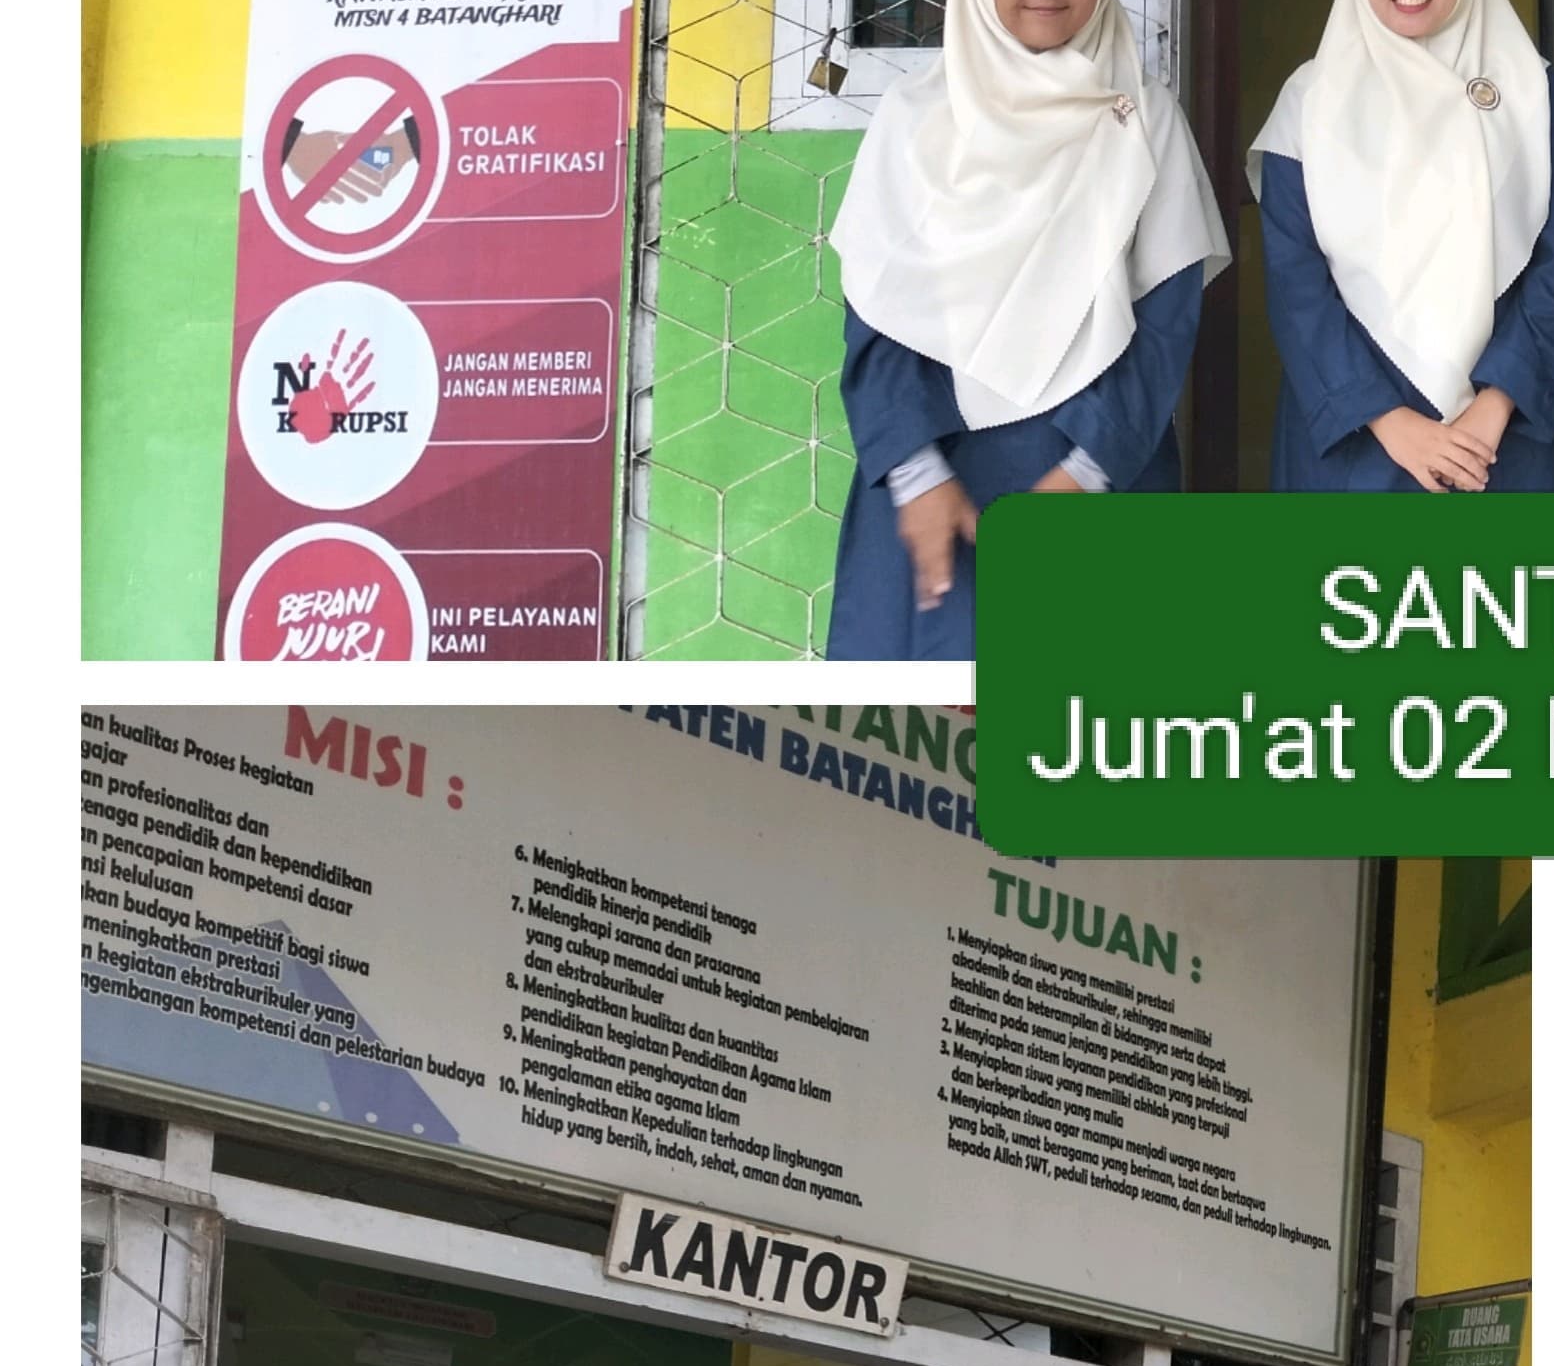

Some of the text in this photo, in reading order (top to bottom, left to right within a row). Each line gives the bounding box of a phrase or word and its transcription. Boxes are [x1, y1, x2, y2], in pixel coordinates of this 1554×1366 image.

[334, 4, 563, 27] MTSN 4 BATANGHARI
[459, 125, 537, 147] TOLAK
[457, 151, 605, 175] GRATIFIKASI
[444, 351, 592, 373] JANGAN MEMBERI
[443, 376, 603, 398] JANGAN MENERIMA
[277, 582, 381, 627] BERANI
[431, 607, 597, 627] INI PELAYANAN
[431, 634, 486, 653] KAMI
[283, 705, 427, 798] MISI
[987, 867, 1178, 975] TUJUAN
[82, 911, 281, 981] meningkatkan prestasi
[505, 971, 779, 1063] 8. Meningkatkan kualitas dan kuantitas
[629, 1207, 887, 1324] KANTOR
[1462, 1304, 1500, 1327] RUANG
[1448, 1324, 1511, 1348] TATA USAHA
